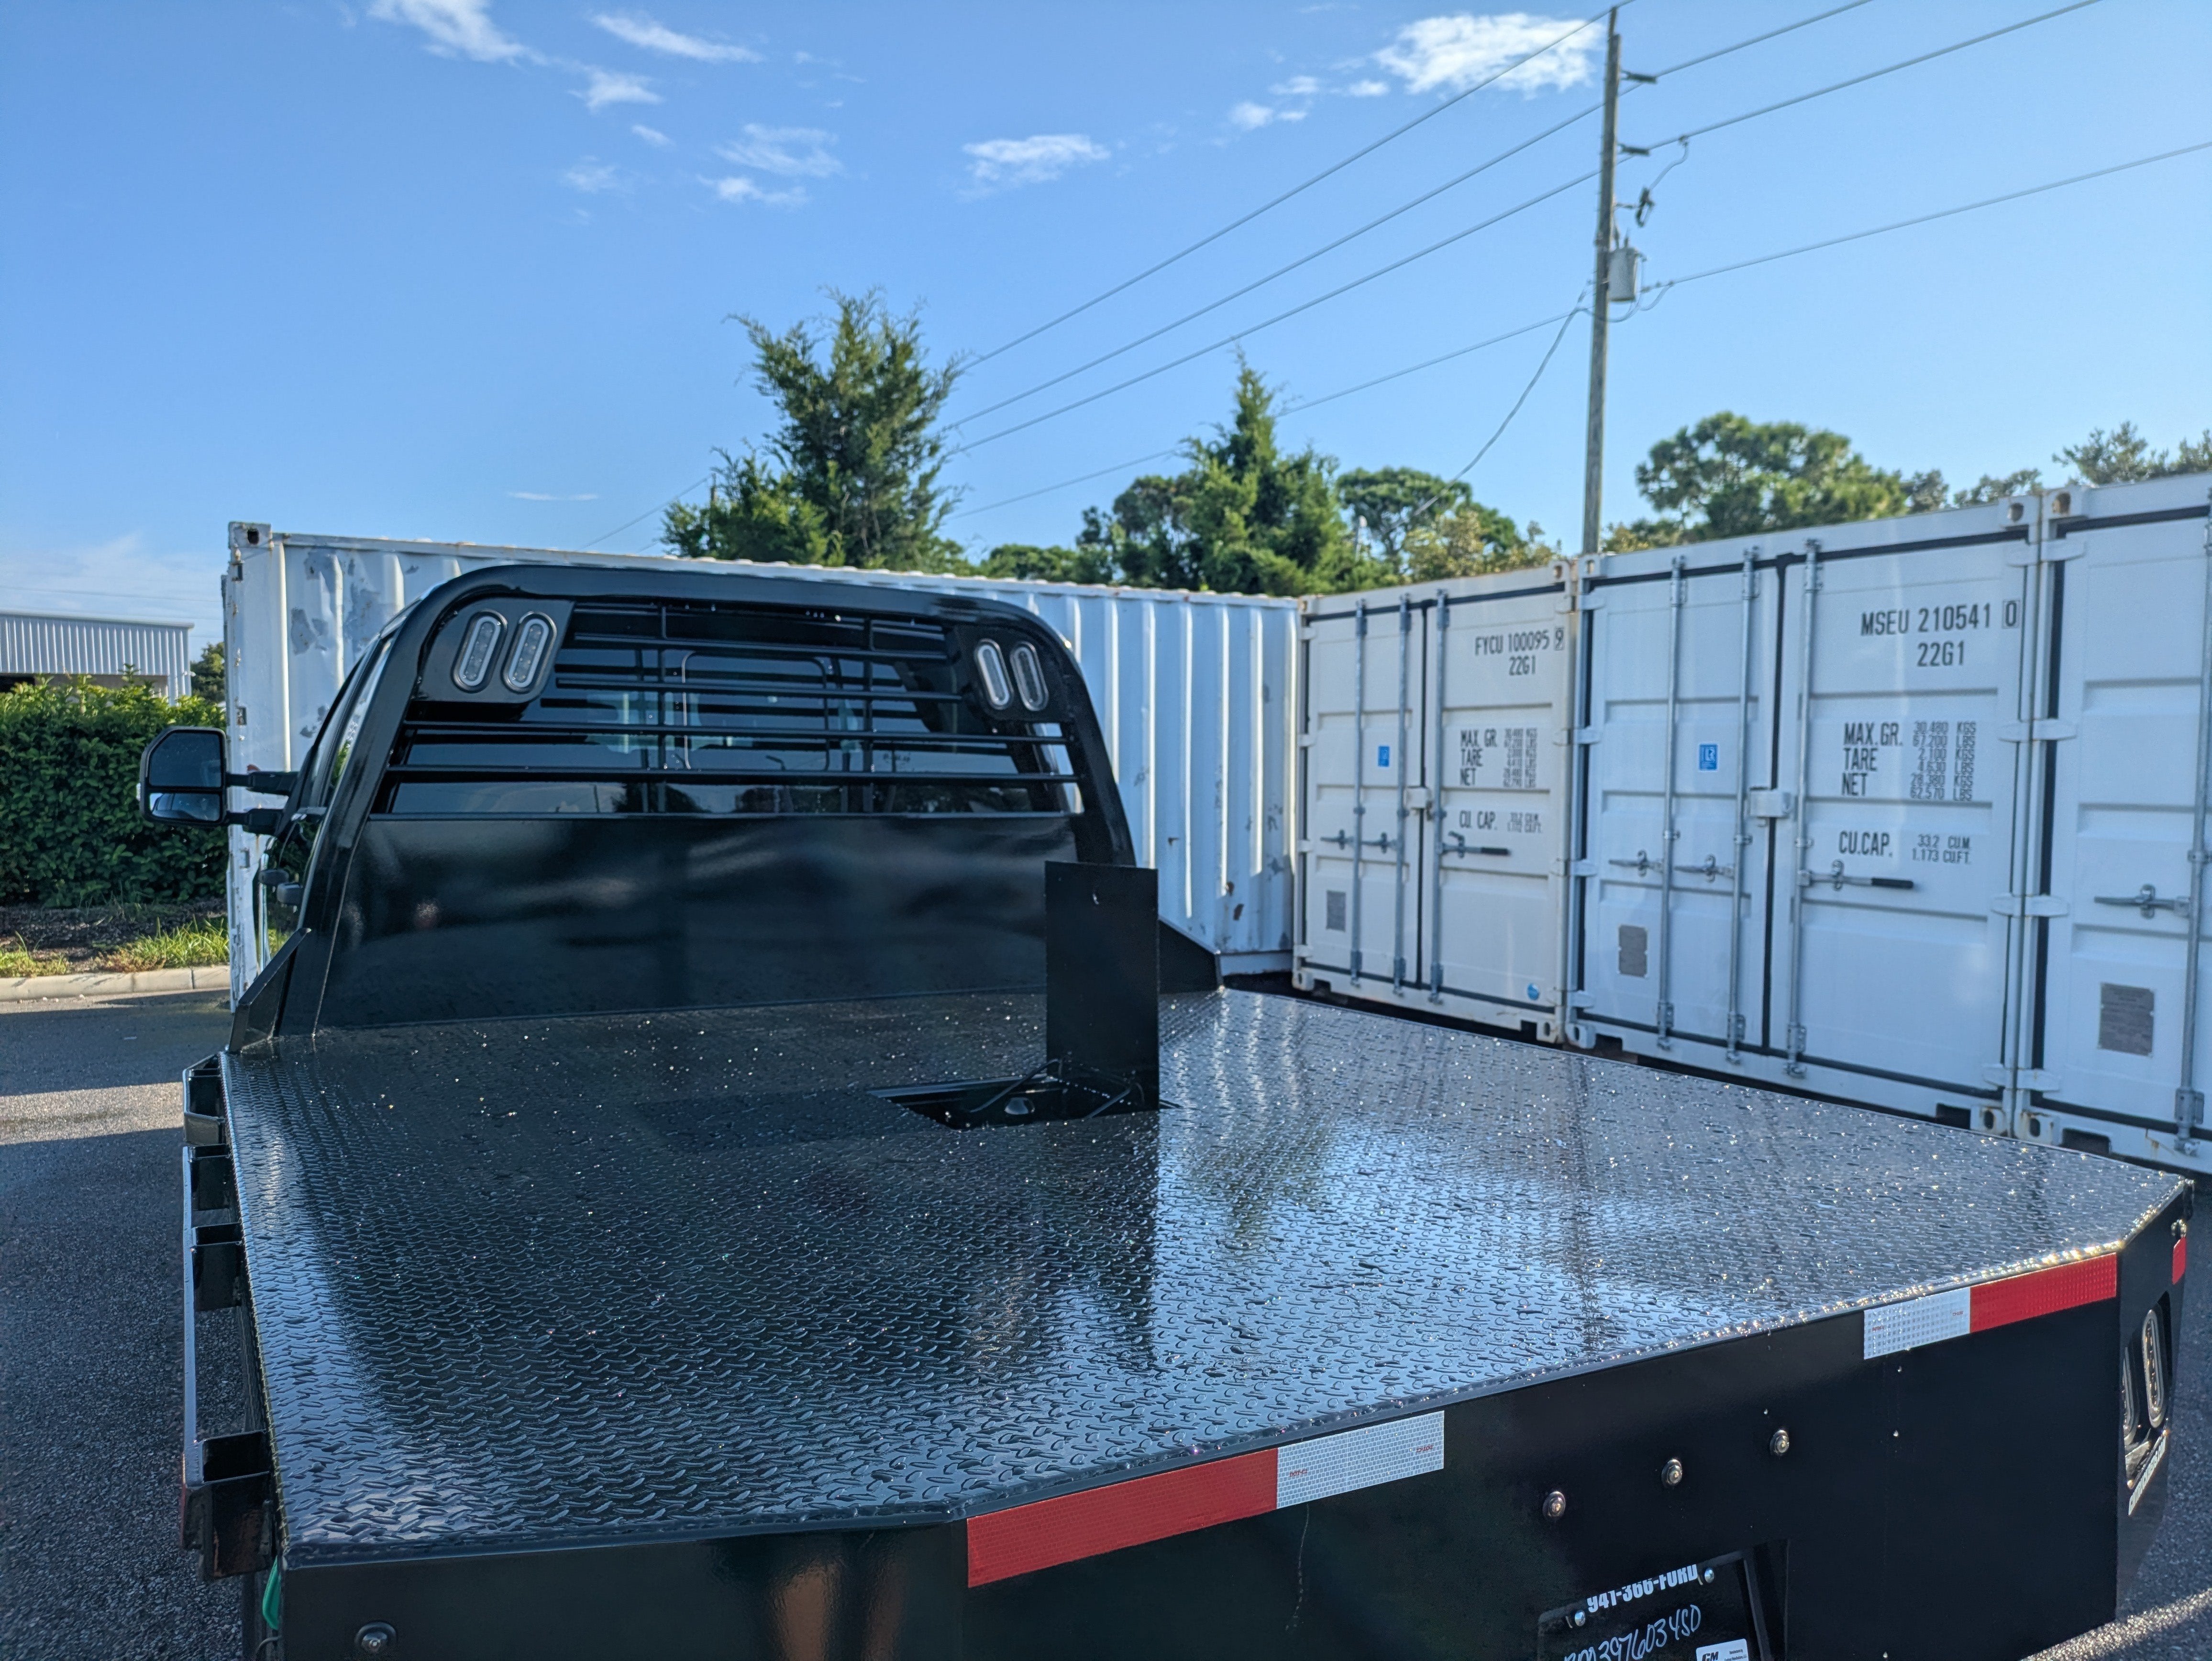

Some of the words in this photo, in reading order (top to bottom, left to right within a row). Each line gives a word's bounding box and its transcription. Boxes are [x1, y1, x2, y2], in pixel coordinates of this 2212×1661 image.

[1860, 609, 1910, 636] MSEU
[1918, 601, 1991, 632] 210541
[2003, 600, 2019, 628] 0
[1475, 634, 1504, 656] FYCU
[1508, 629, 1550, 652] 100095
[1554, 627, 1565, 650] 9
[1917, 640, 1964, 667] 22G1
[1509, 655, 1537, 675] 22G1
[1461, 748, 1484, 767] TARE
[1844, 747, 1879, 772] TARE
[1460, 768, 1476, 786] NET
[1842, 772, 1868, 797] NET
